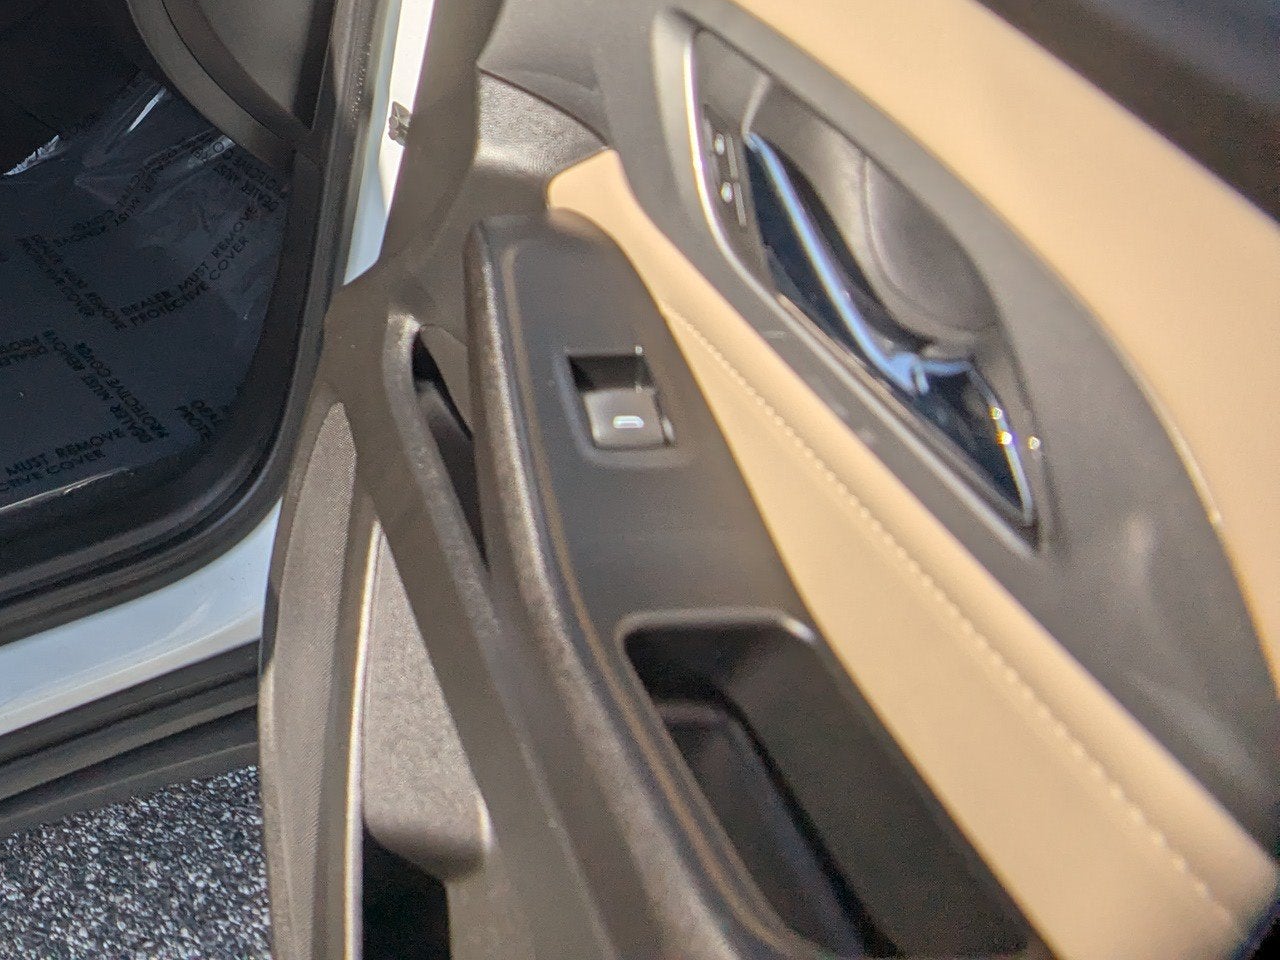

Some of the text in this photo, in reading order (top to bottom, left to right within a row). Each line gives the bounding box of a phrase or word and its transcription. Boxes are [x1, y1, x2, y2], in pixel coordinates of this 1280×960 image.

[120, 204, 257, 316] DEALER MUST REMOVE
[129, 235, 250, 327] PROTECTIVE COVER
[80, 373, 114, 401] MUST
[105, 378, 170, 439] PROTECTIVE
[110, 403, 155, 443] DEALER
[4, 453, 49, 477] MUST
[54, 427, 126, 458] REMOVE
[45, 448, 107, 477] COVER
